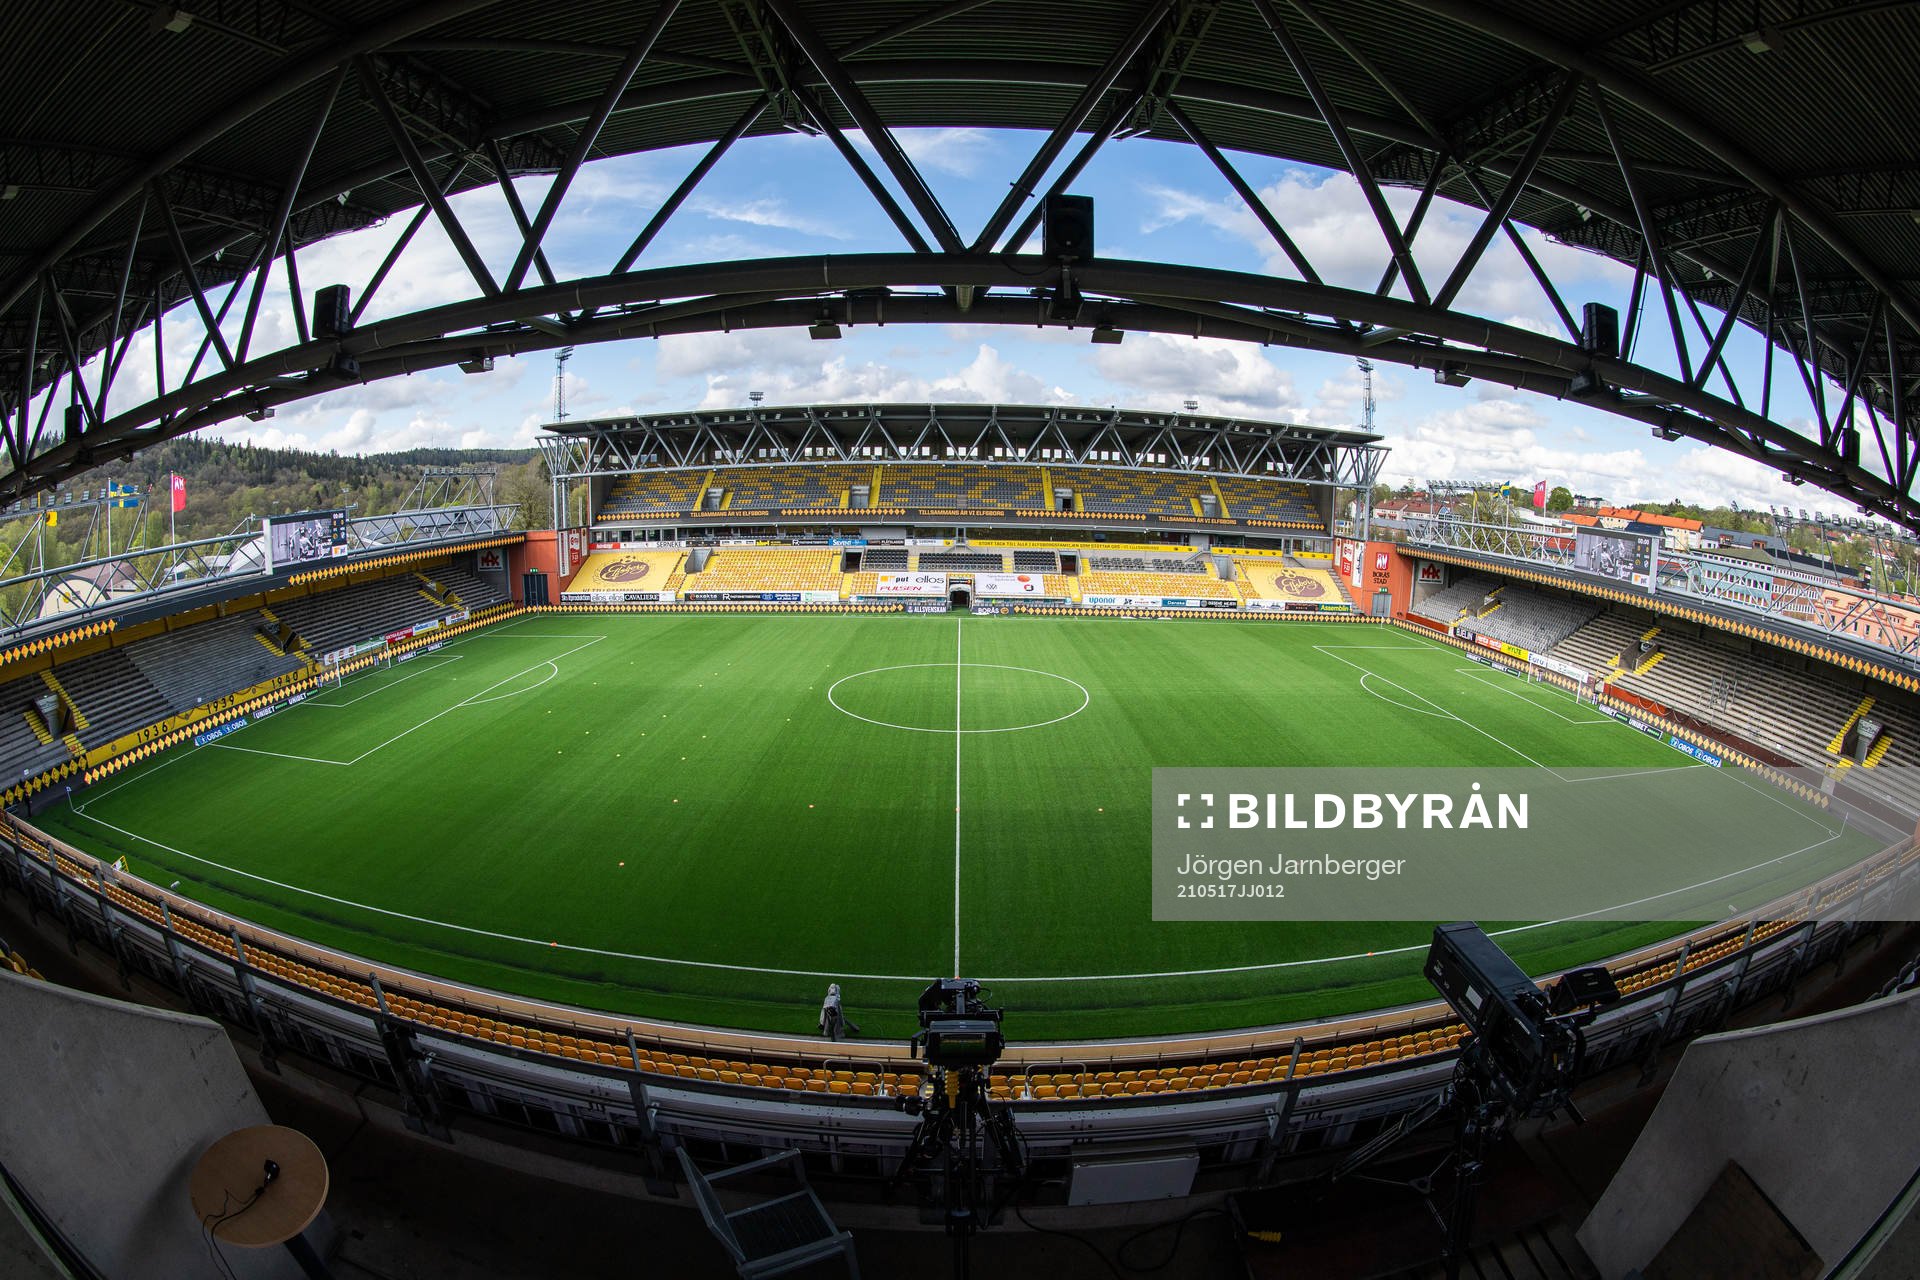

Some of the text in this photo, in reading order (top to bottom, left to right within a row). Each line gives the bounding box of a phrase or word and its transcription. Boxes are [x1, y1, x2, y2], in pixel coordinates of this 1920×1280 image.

[915, 575, 945, 584] ellos
[1422, 563, 1440, 579] MAX
[978, 606, 999, 614] BORÅS
[137, 672, 299, 744] 1936 1939 1940
[255, 706, 275, 719] UNIBET
[288, 692, 307, 704] UNIBET
[1599, 704, 1616, 717] UNIBET
[1628, 718, 1648, 732] UNIBET
[207, 731, 222, 741] OBOS
[1678, 742, 1718, 766] OBOS OBOS
